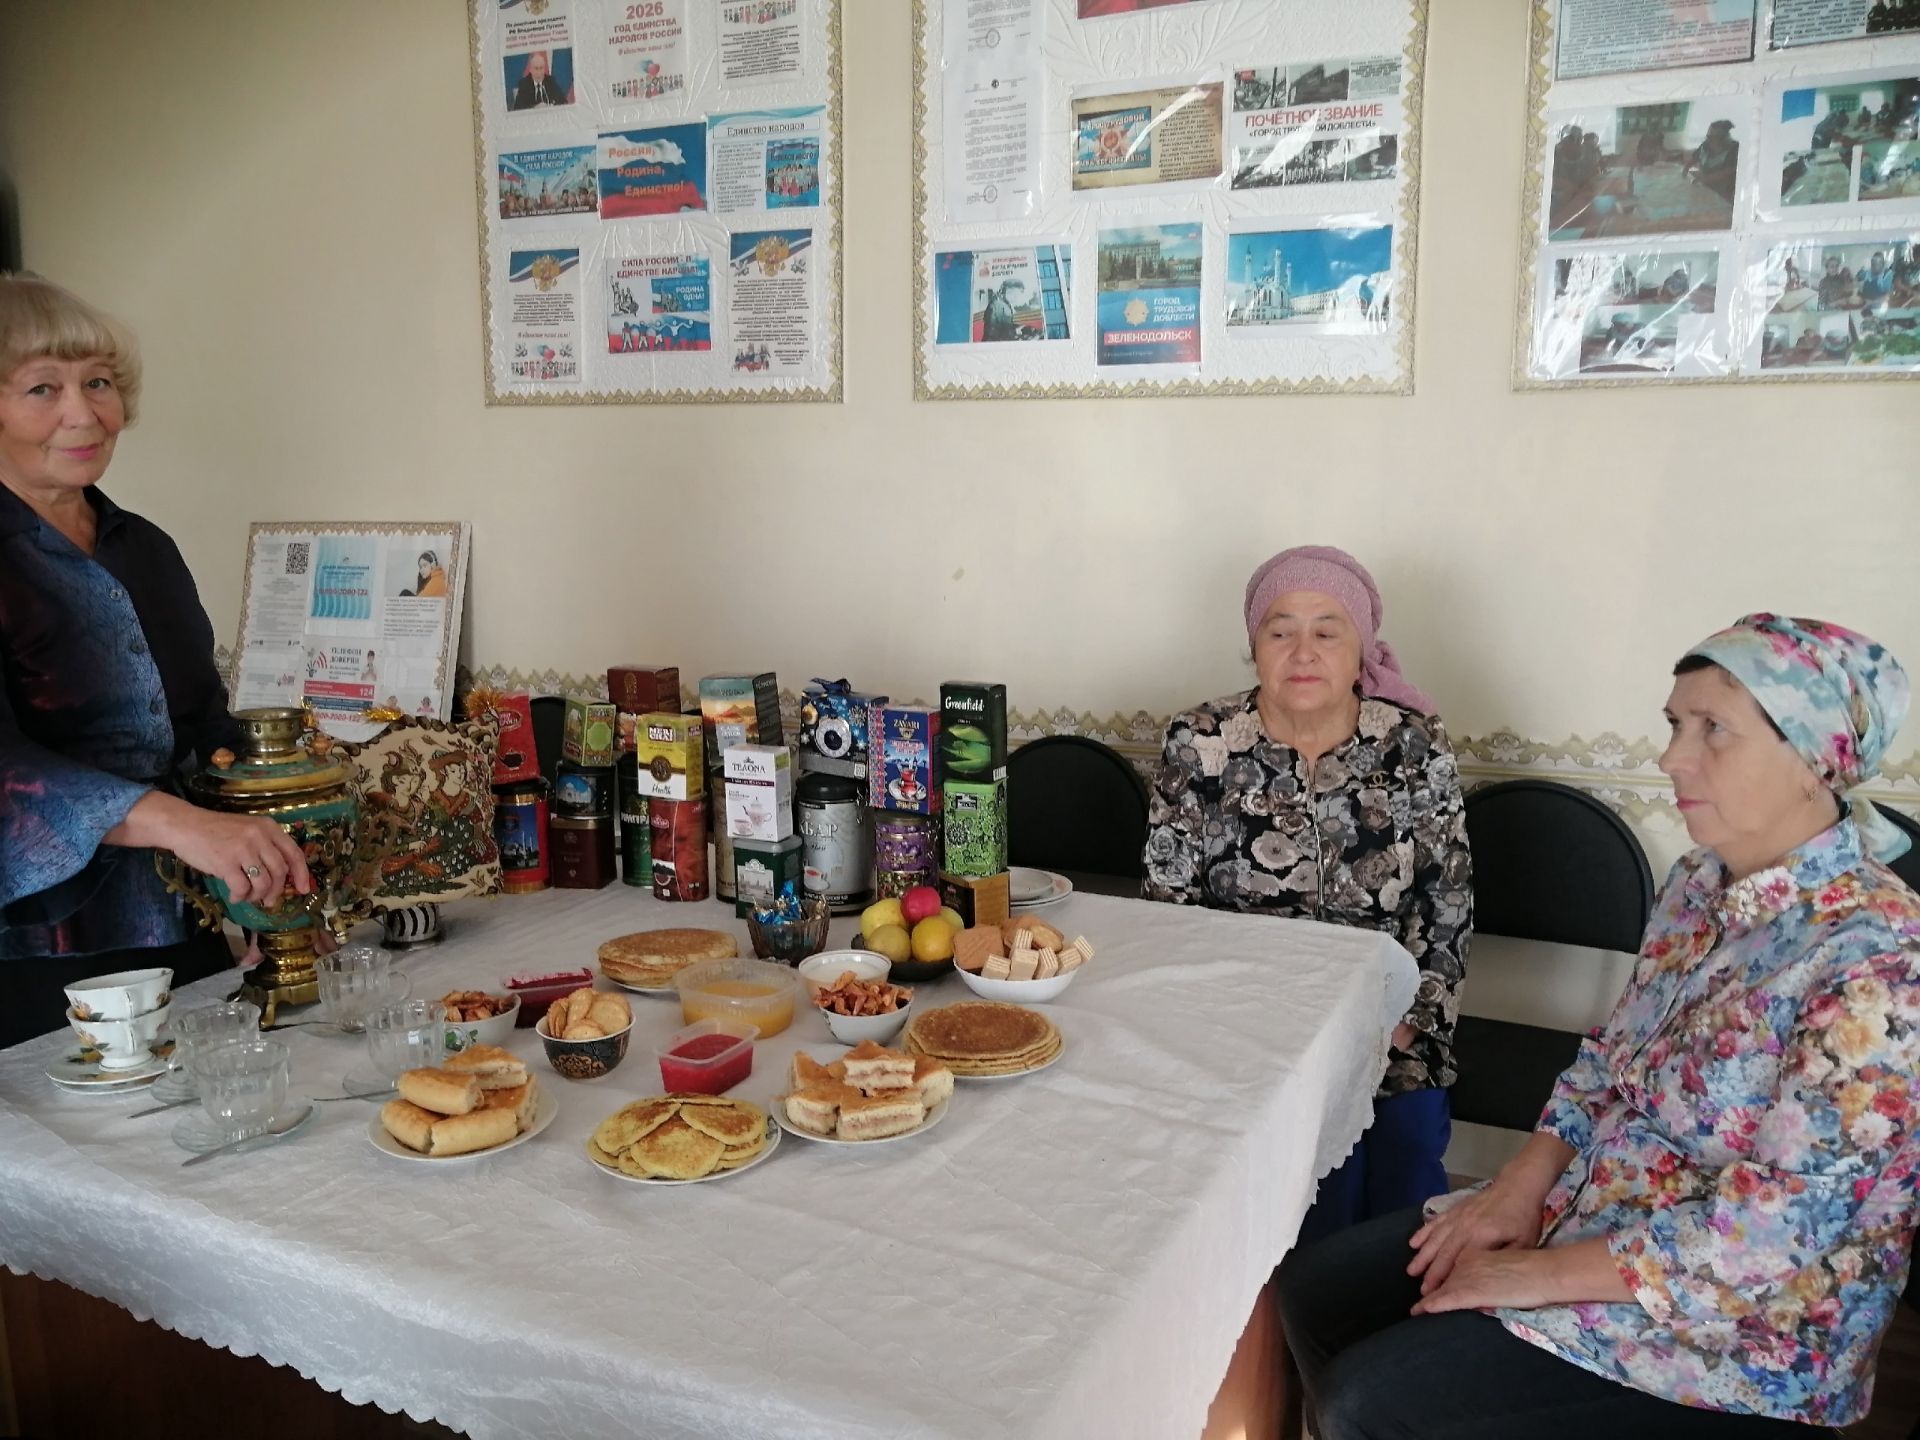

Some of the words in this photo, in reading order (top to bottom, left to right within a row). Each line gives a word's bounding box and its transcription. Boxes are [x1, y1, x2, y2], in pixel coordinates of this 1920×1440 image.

[626, 2, 664, 20] 2026
[614, 23, 631, 33] ГОД
[633, 17, 677, 31] ЕДИНСТВА
[609, 31, 648, 45] НАРОДОВ
[650, 27, 682, 39] РОССИИ
[1324, 103, 1384, 121] ЗВАНИЕ
[727, 126, 767, 137] Единство
[769, 122, 805, 134] народов
[608, 147, 657, 159] Россия,
[616, 167, 665, 179] Родина,
[625, 180, 684, 197] Единство!
[622, 258, 644, 267] СИЛА
[645, 255, 679, 266] РОССИИ
[675, 286, 705, 294] РОДИНА
[1153, 296, 1180, 305] ГОРОД
[1154, 303, 1195, 314] ТРУДОВОЙ
[1153, 313, 1195, 322] ДОБЛЕСТИ
[1107, 330, 1192, 344] ЗЕЛЕНОДОЛЬСК
[360, 687, 374, 697] 124
[945, 695, 984, 712] Greenfield
[893, 719, 920, 730] ZAVARI
[732, 762, 766, 774] TEAONA
